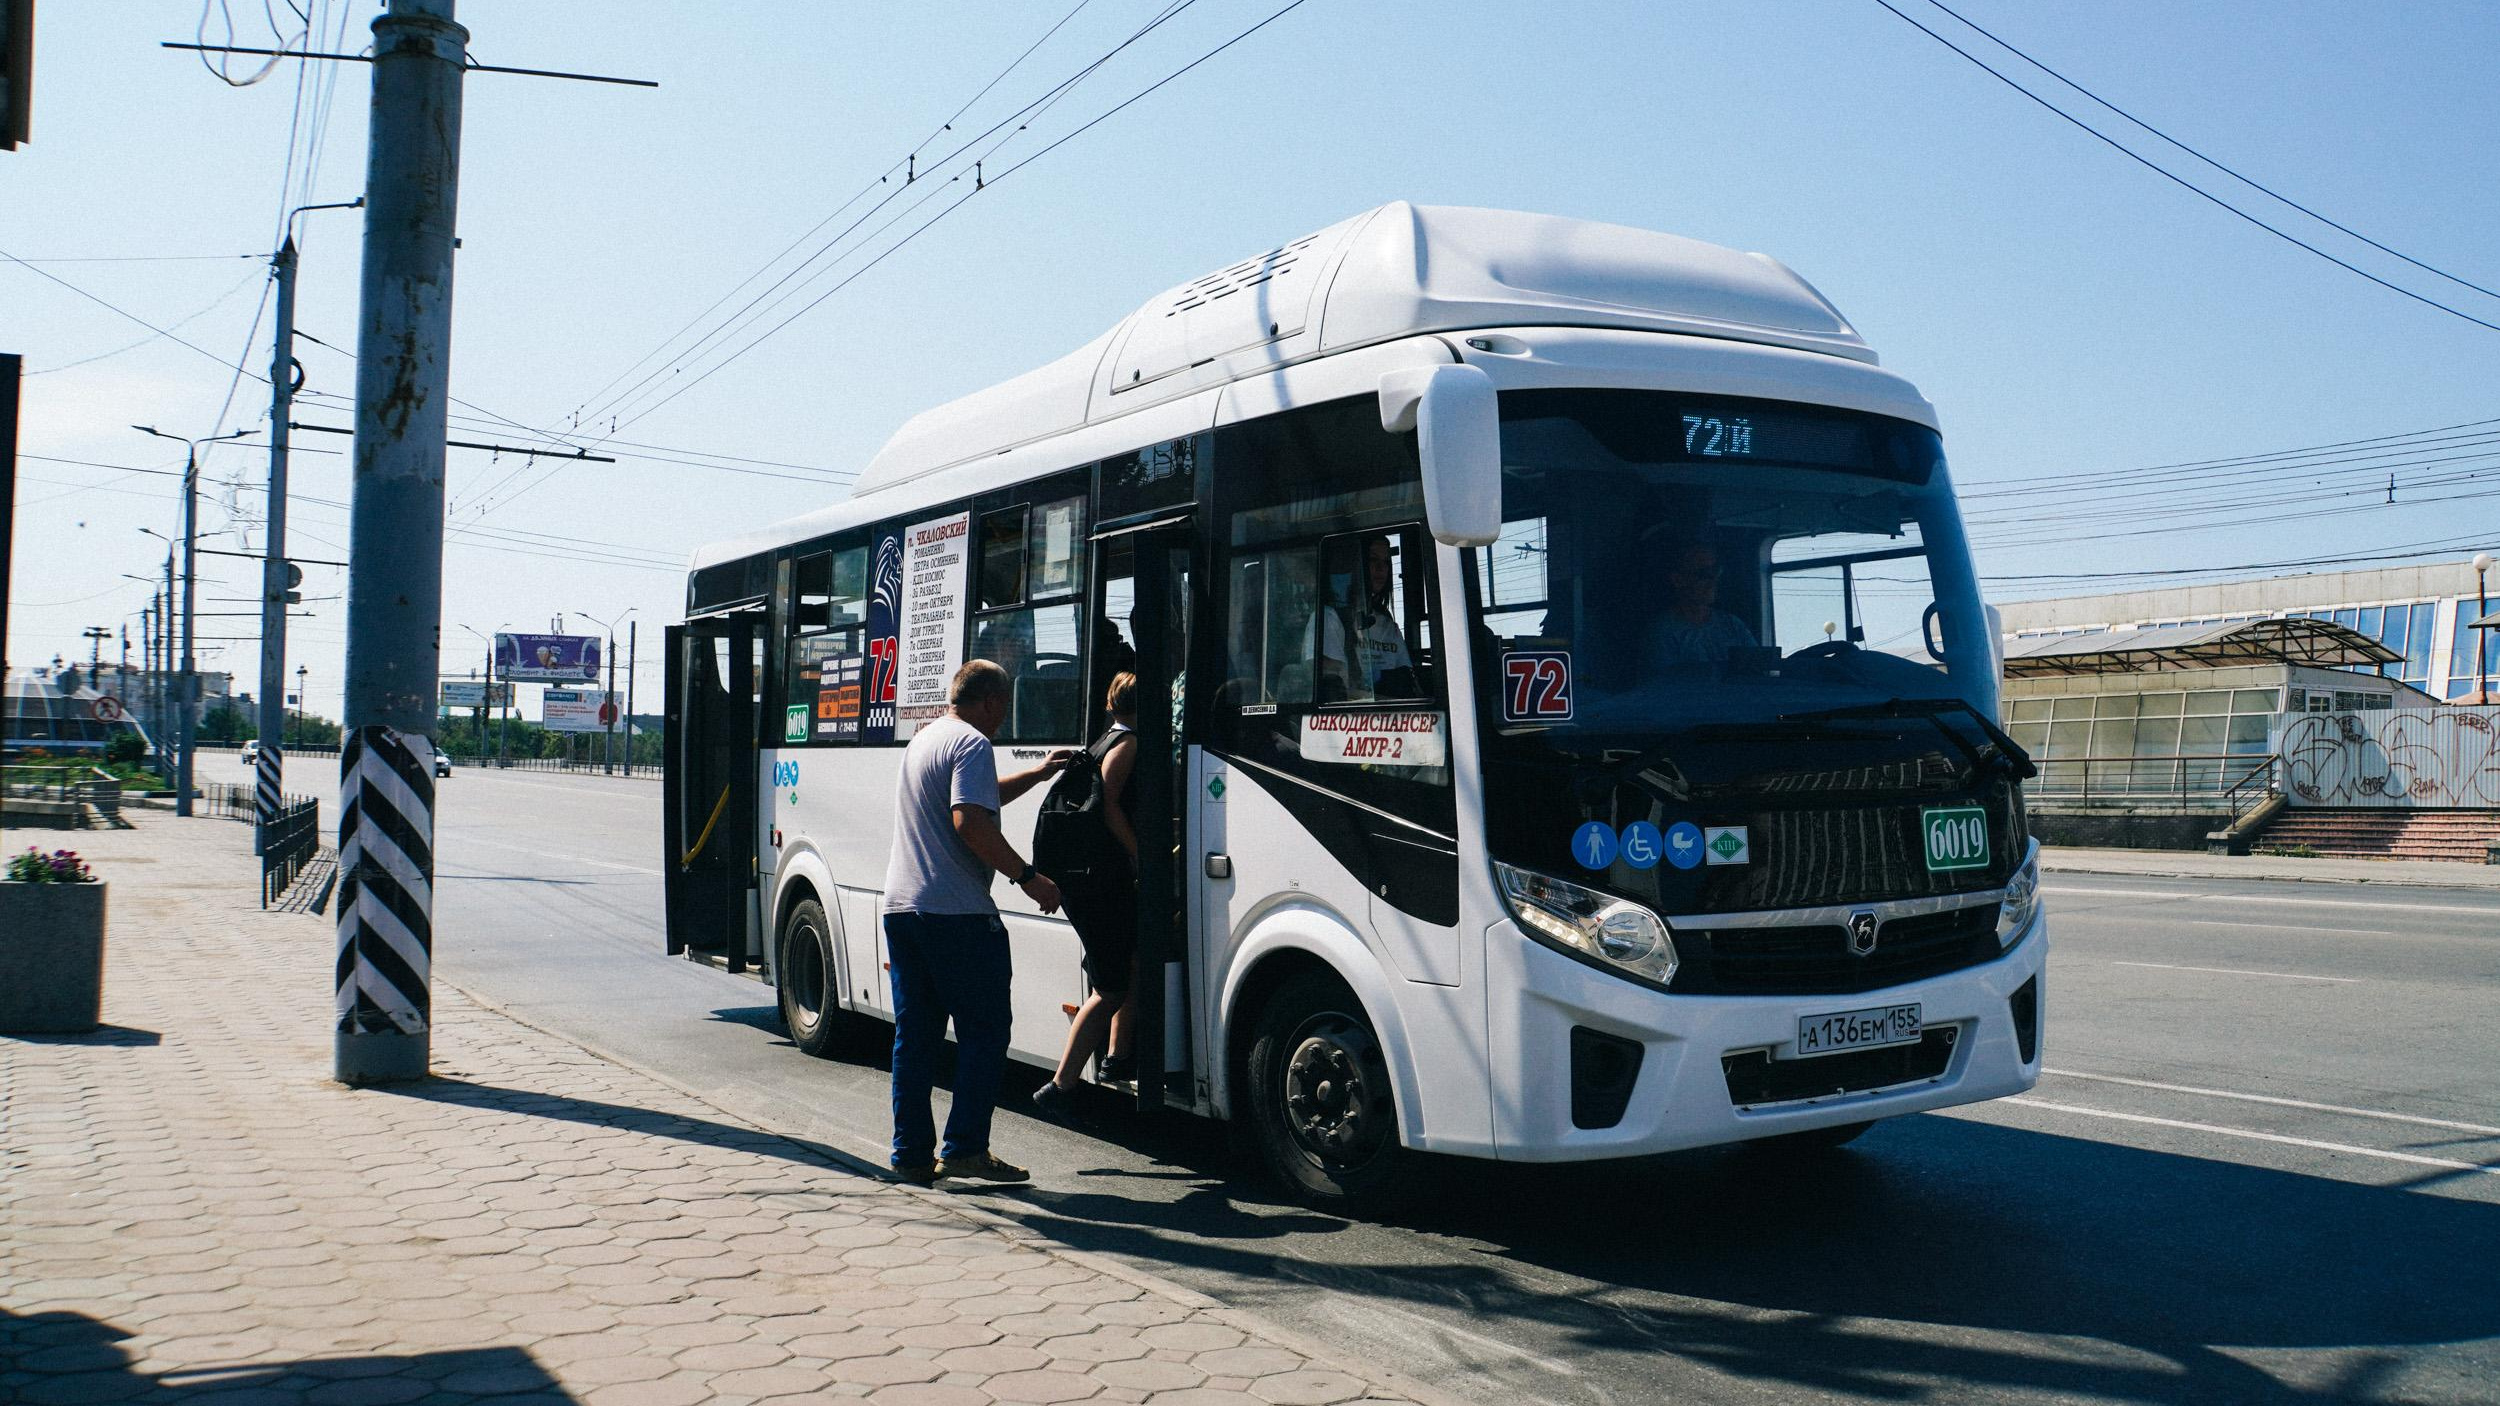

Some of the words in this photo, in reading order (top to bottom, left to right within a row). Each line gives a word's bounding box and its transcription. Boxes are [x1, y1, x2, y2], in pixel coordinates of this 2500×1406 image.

[917, 515, 967, 545] ЧКАЛОВСКИЙ
[913, 543, 945, 559] РОМАНЕНКО
[913, 560, 930, 572] ПЕТРА
[924, 569, 945, 583] КОСМОС
[929, 594, 953, 609] ОКТЯБРЯ
[911, 610, 946, 625] ТЕАТРАЛЬНАЯ
[922, 623, 944, 637] ТУРИСТА
[917, 637, 943, 650] СЕВЕРНАЯ
[919, 650, 945, 663] СЕВЕРНАЯ
[870, 636, 897, 703] 72
[918, 664, 945, 676] АМУРСКАЯ
[907, 678, 939, 690] ЗАВЕРТЯЕВА
[1507, 658, 1569, 714] 72
[913, 687, 947, 703] КИРПИЧНЫЙ
[787, 710, 807, 736] 6019
[1309, 713, 1440, 735] ОНКОДИСПАНСЕР
[1342, 737, 1403, 759] АМУР-2
[1930, 817, 1984, 860] 6019
[1888, 1007, 1916, 1030] 155
[1894, 1028, 1909, 1038] RUS
